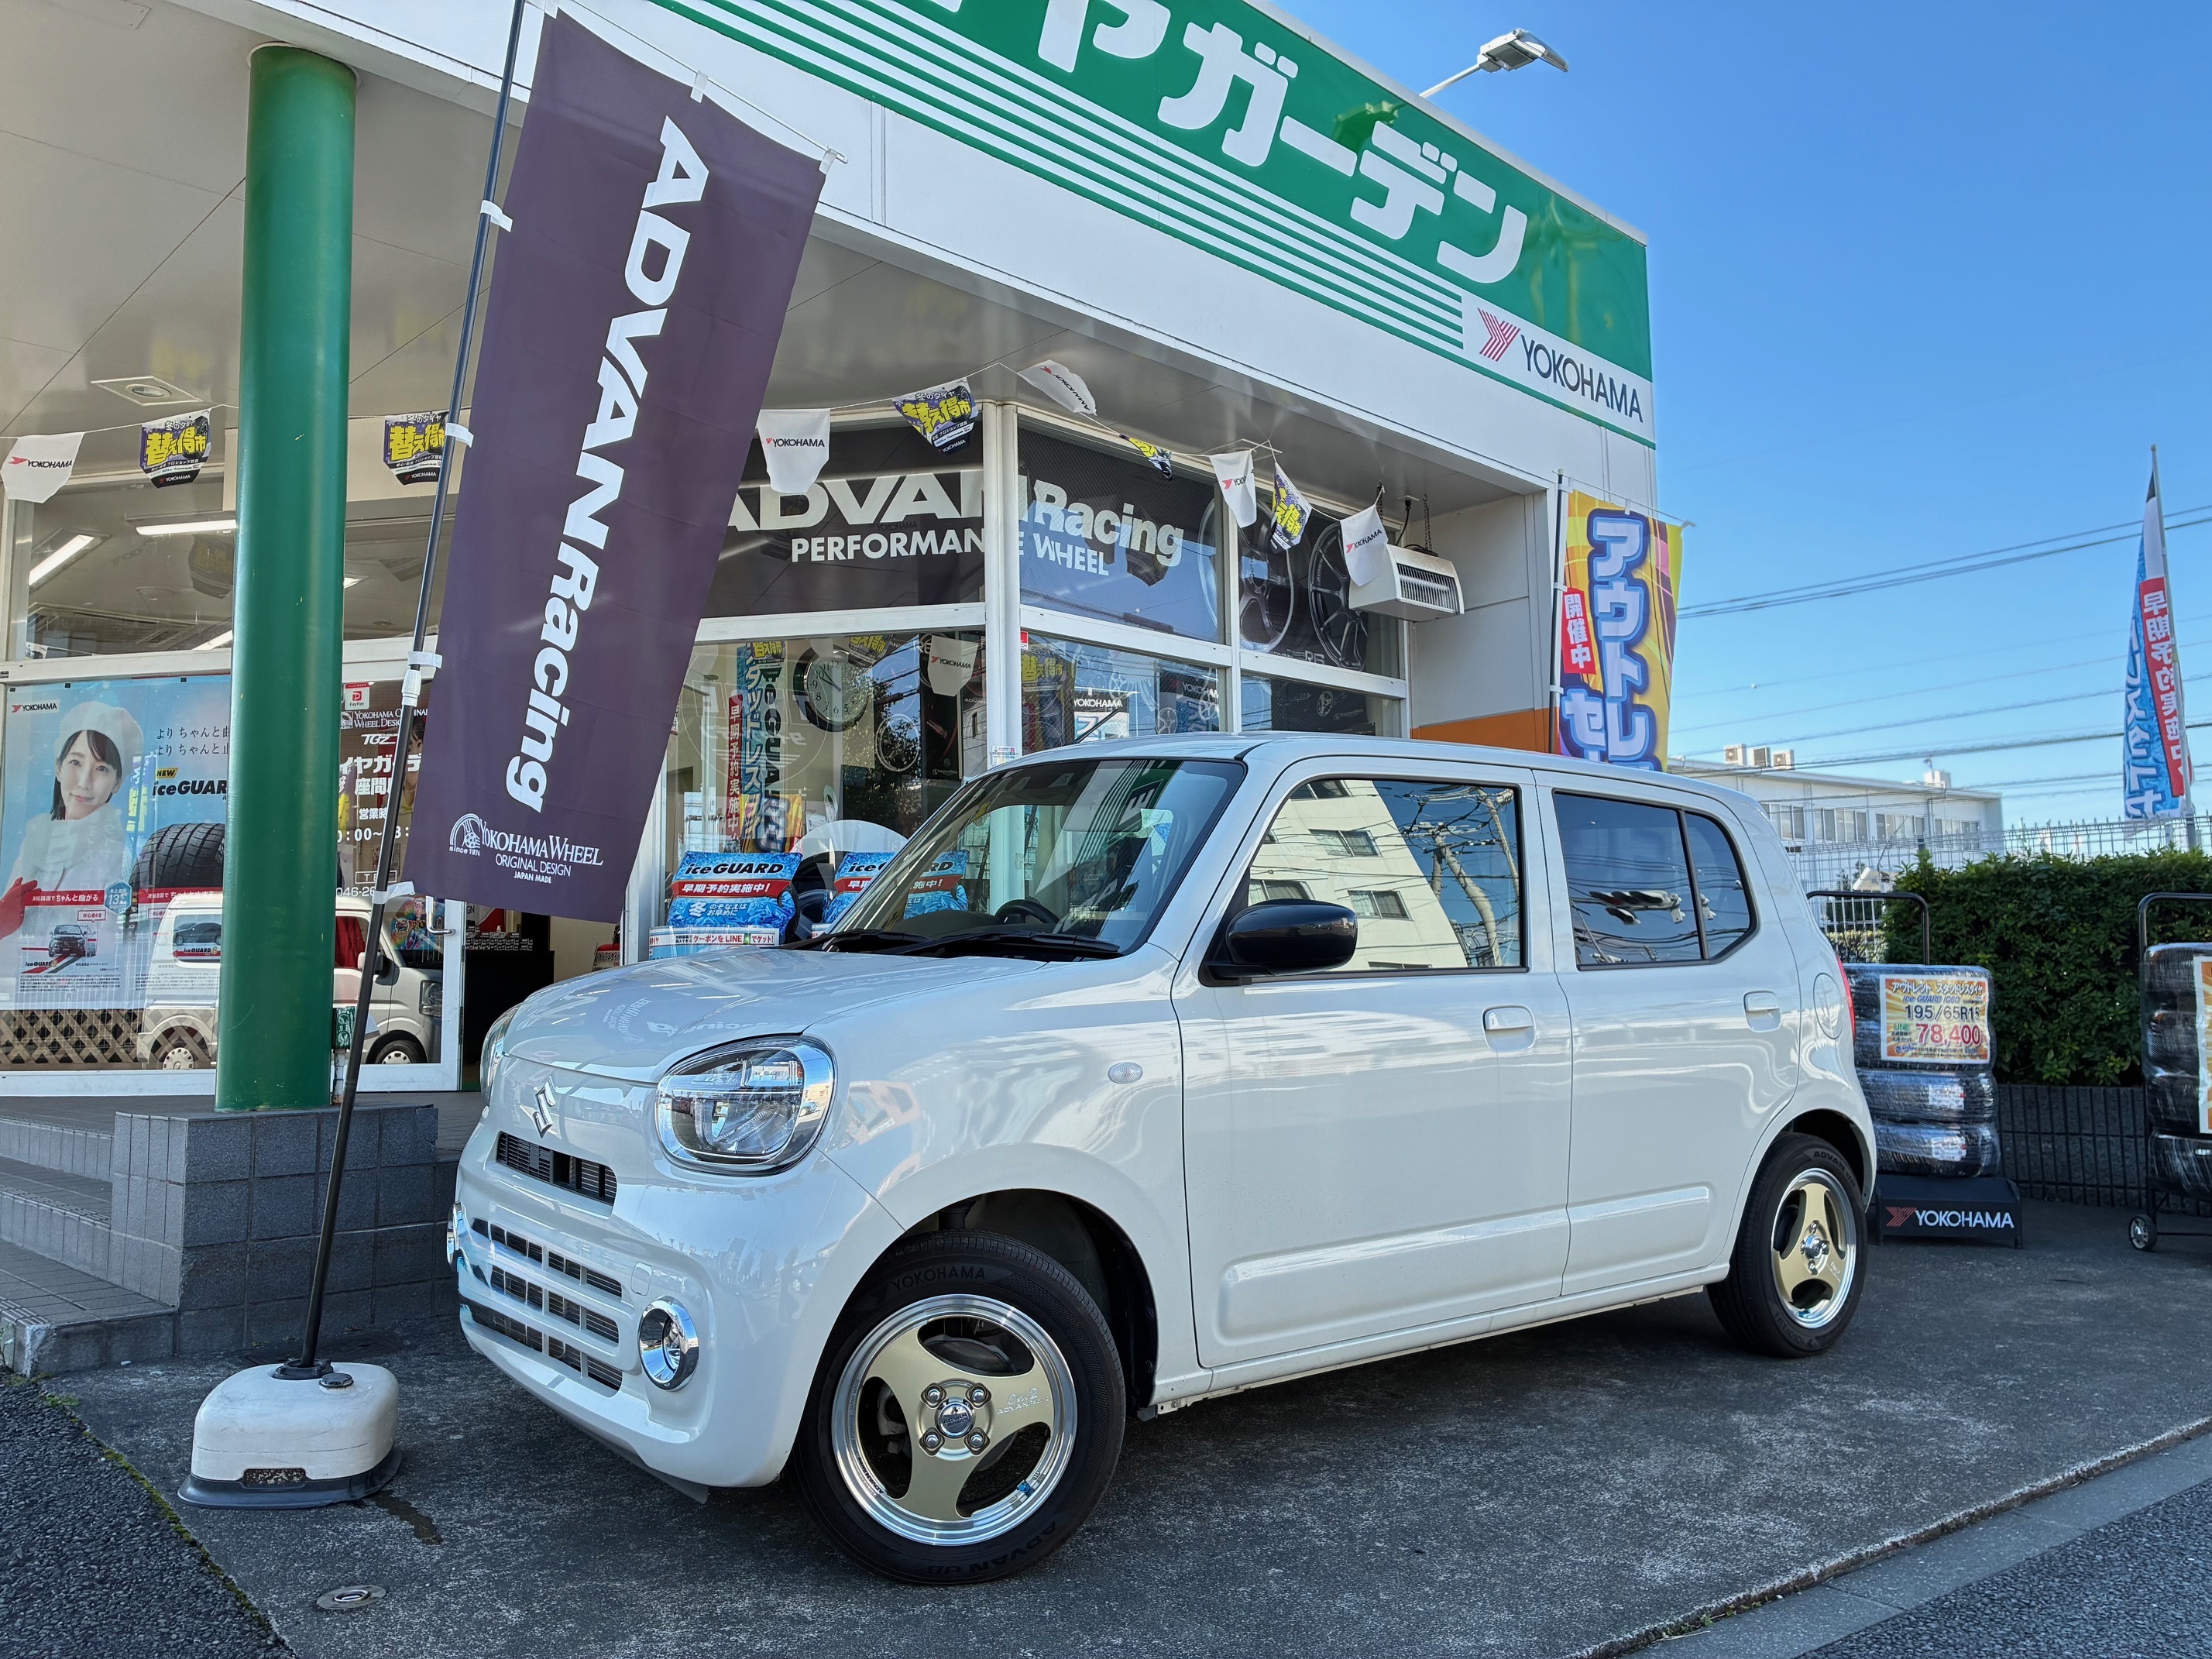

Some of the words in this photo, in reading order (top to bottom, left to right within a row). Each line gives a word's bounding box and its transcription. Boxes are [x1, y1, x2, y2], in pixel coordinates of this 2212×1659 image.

[1520, 334, 1644, 423] YOKOHAMA
[773, 438, 825, 448] YOKOHAMA
[27, 459, 73, 469] YOKOHAMA
[1034, 533, 1109, 577] WHEEL
[1564, 592, 1592, 669] 開催中
[1593, 517, 1654, 770] アウトレ
[939, 658, 971, 668] YOKOHAMA
[22, 702, 57, 712] YOKOHAMA
[1073, 698, 1123, 708] YOKOHAMA
[354, 710, 393, 720] YOKOHAMA
[354, 720, 380, 728] WHEEL
[354, 777, 393, 795] 座間
[359, 808, 387, 819] 営業時
[479, 819, 548, 858] YOKOHAMA
[549, 834, 603, 866] WHEEL
[449, 846, 468, 854] since
[496, 854, 538, 872] ORIGINAL
[540, 861, 572, 877] DESIGN
[514, 871, 534, 881] JAPAN
[535, 874, 552, 884] MADE
[682, 882, 771, 894] 早期予約実施中!
[1915, 1023, 1981, 1046] 78,400
[1814, 1150, 1845, 1172] ADVAN
[1915, 1210, 2014, 1228] YOKOHAMA
[891, 1266, 986, 1292] YOKOHAMA
[943, 1413, 967, 1424] ADVAN
